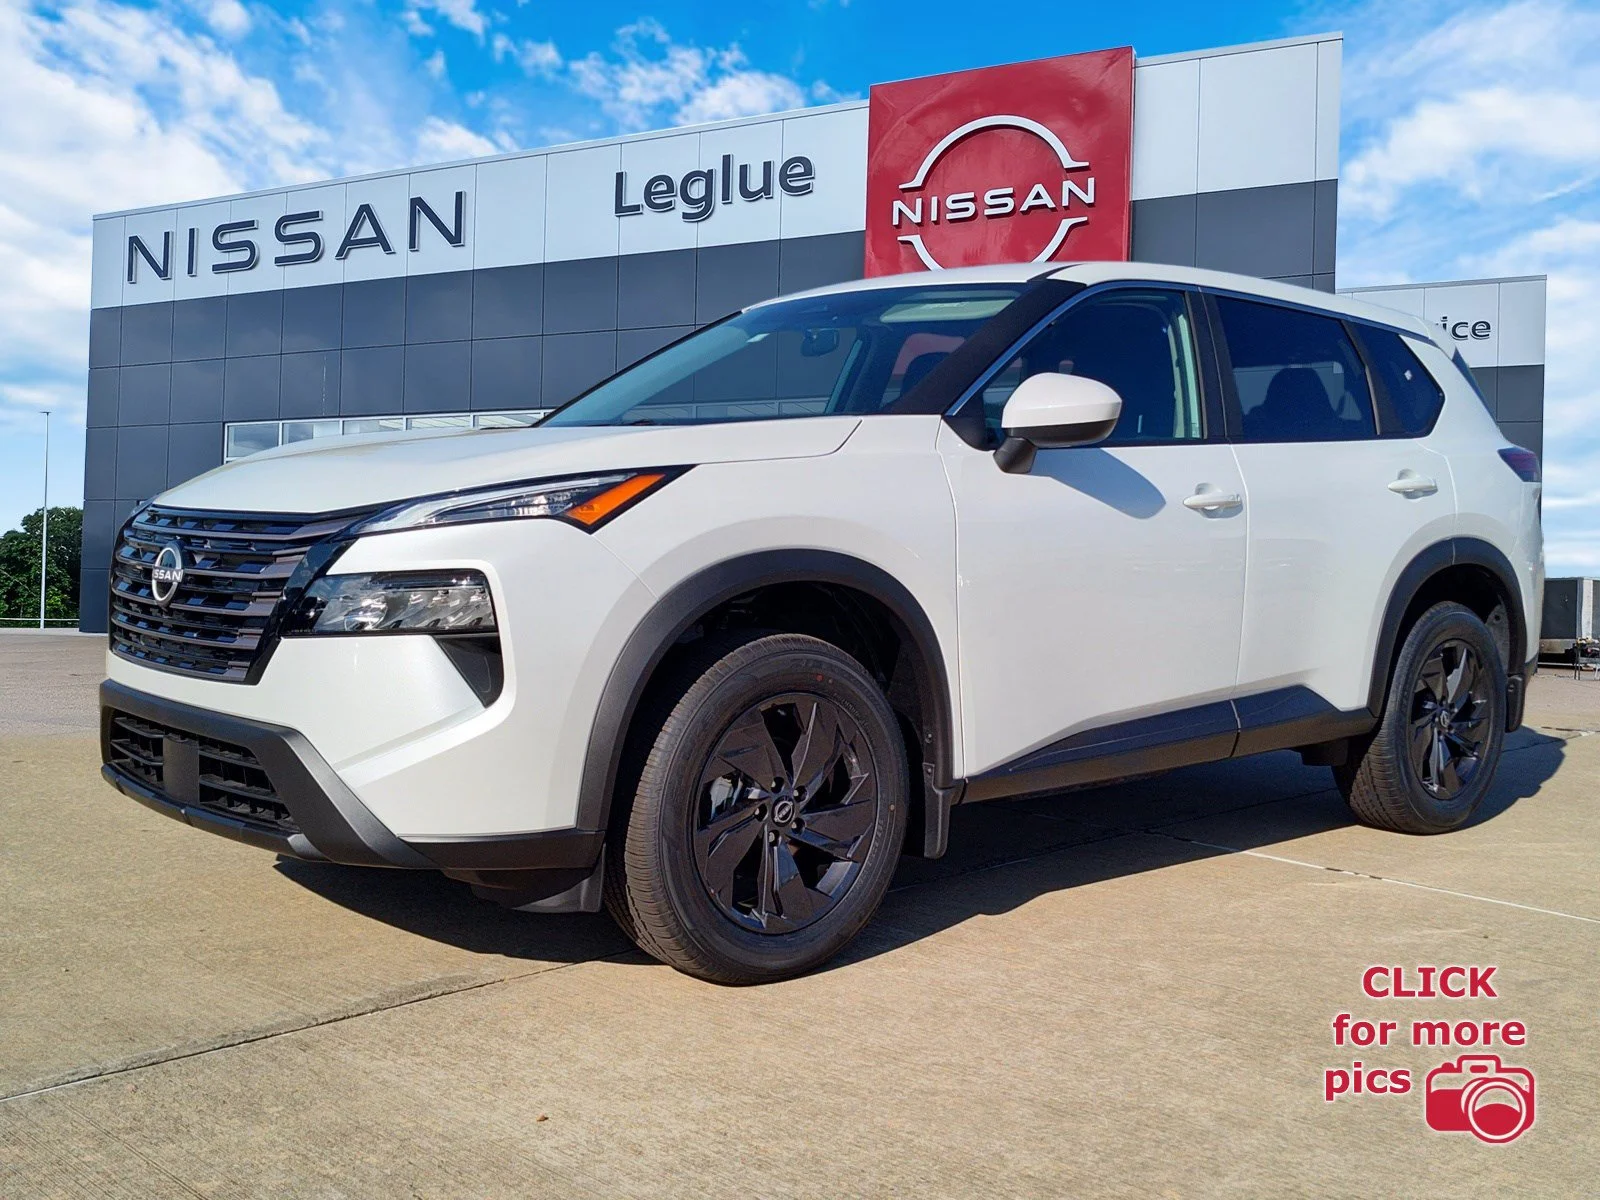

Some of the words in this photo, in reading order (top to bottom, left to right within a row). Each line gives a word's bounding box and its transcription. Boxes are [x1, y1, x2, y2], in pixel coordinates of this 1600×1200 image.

[615, 153, 815, 223] Leglue
[892, 177, 1095, 226] NISSAN
[127, 190, 466, 284] NISSAN
[1435, 315, 1492, 341] ice
